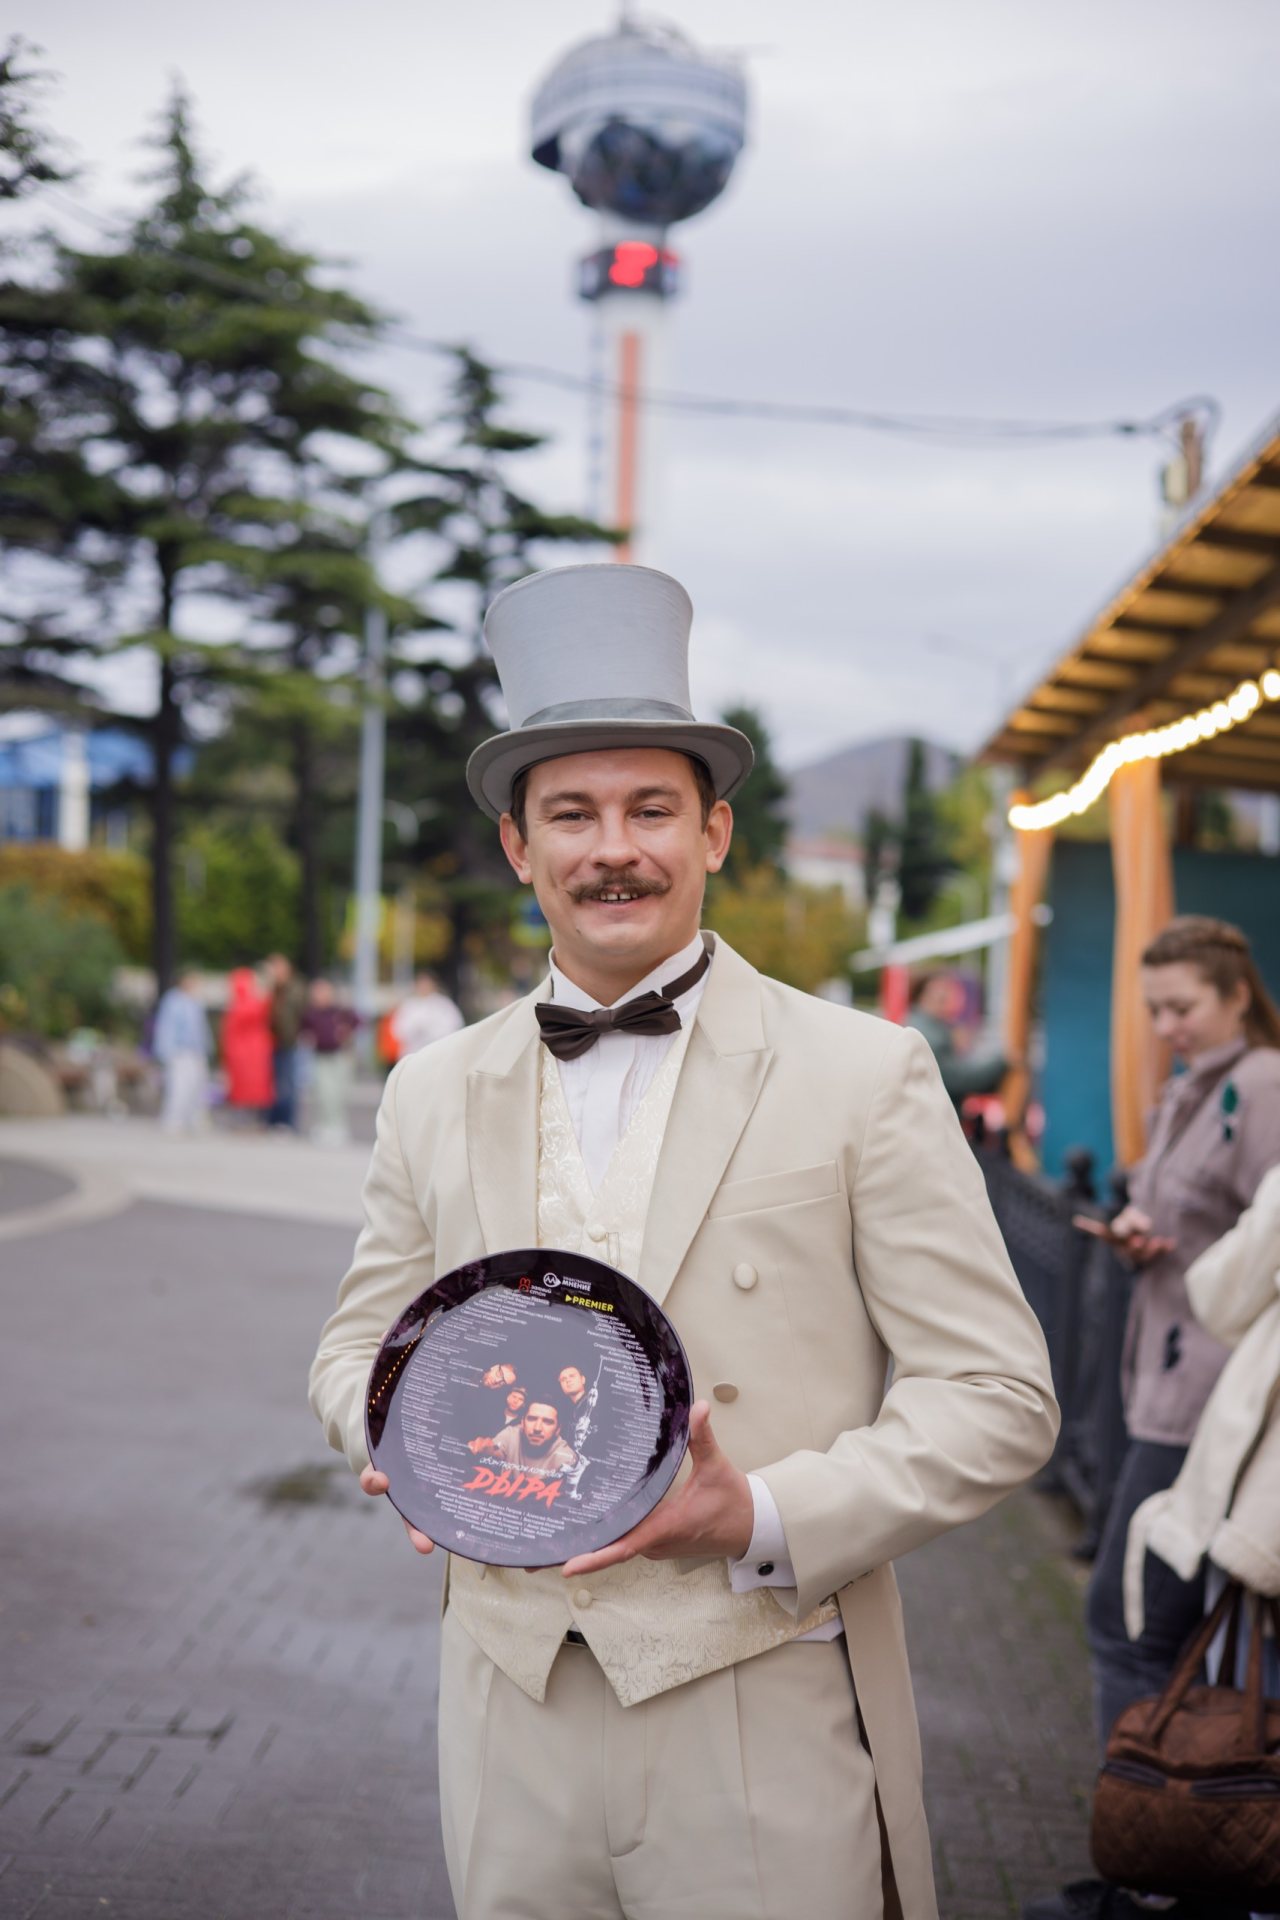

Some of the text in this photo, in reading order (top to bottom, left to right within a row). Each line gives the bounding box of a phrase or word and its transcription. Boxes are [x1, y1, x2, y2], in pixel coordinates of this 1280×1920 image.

[562, 1280, 591, 1291] МНЕНИЕ
[573, 1296, 614, 1312] PREMIER
[462, 1466, 563, 1511] ДЫРА
